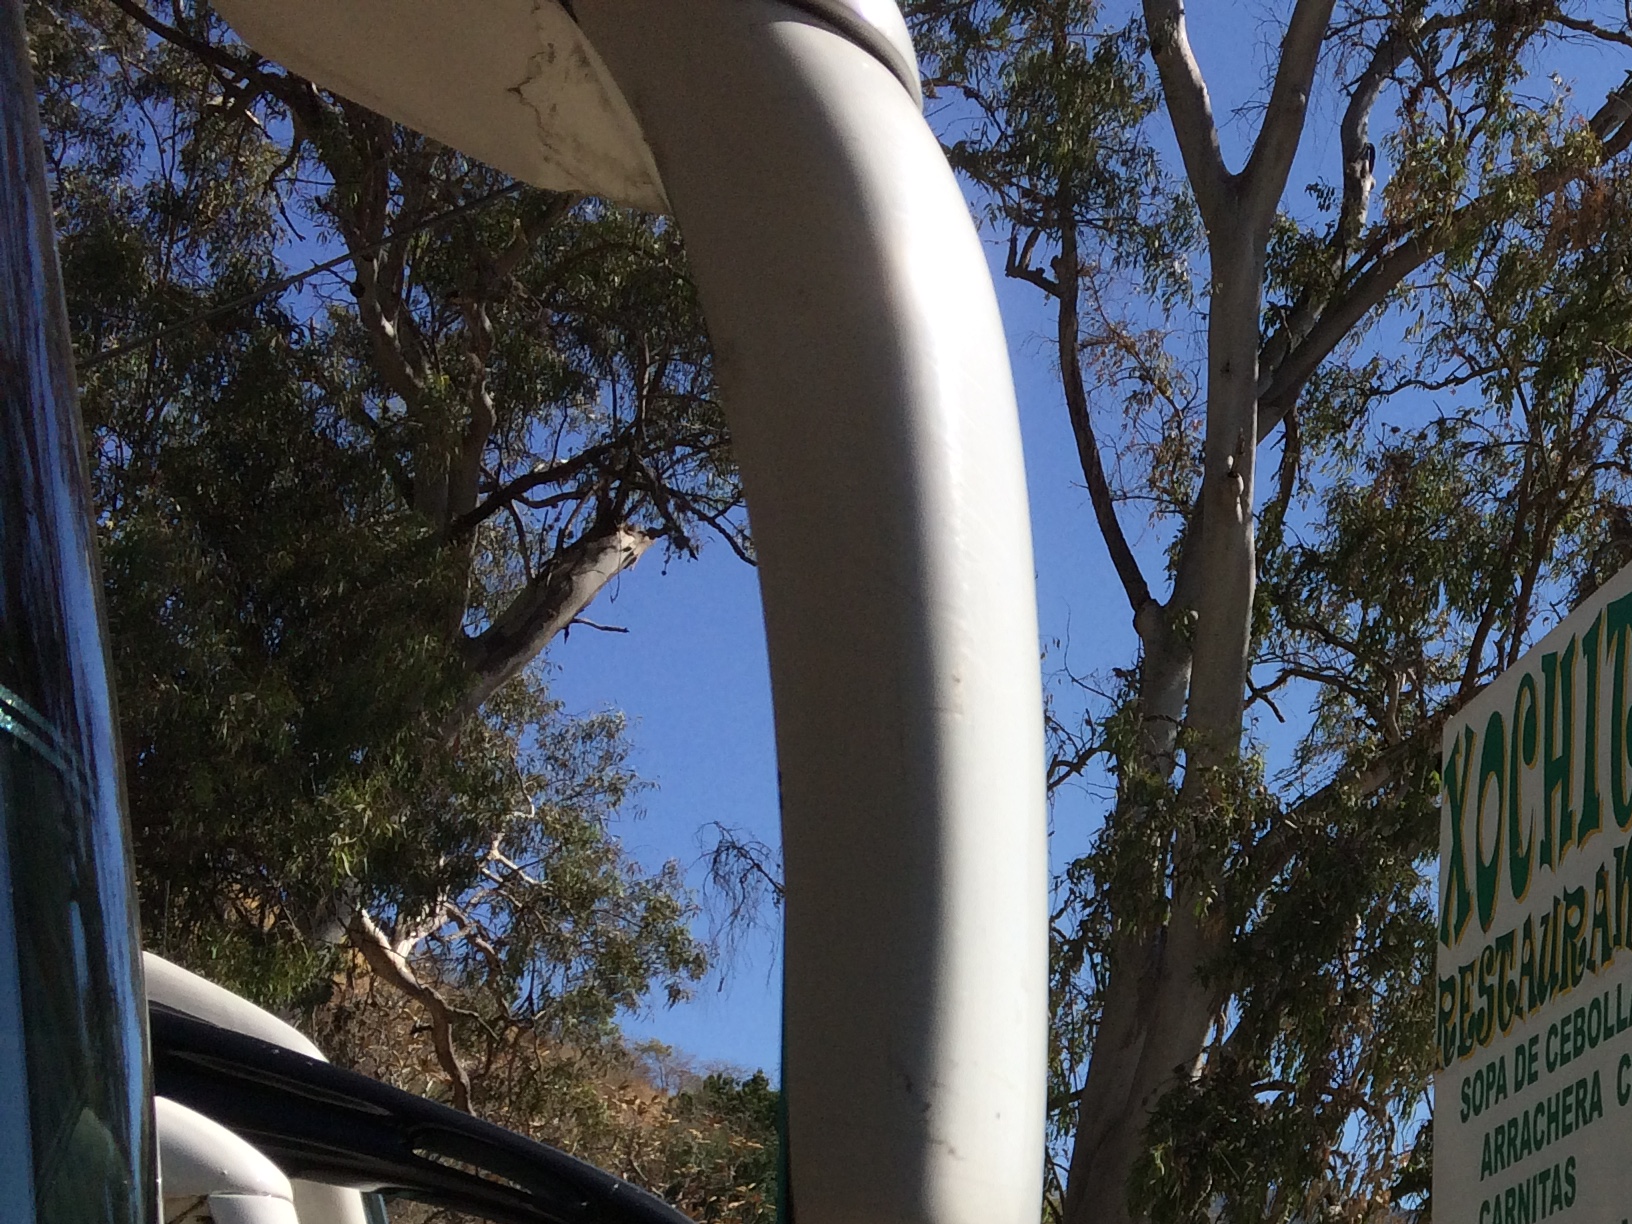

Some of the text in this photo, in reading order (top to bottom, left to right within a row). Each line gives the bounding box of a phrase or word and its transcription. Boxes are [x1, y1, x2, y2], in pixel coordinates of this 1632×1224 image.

[1460, 1055, 1508, 1124] SOPA
[1514, 1031, 1539, 1094] DE
[1480, 1071, 1603, 1181] ARRACHERA
